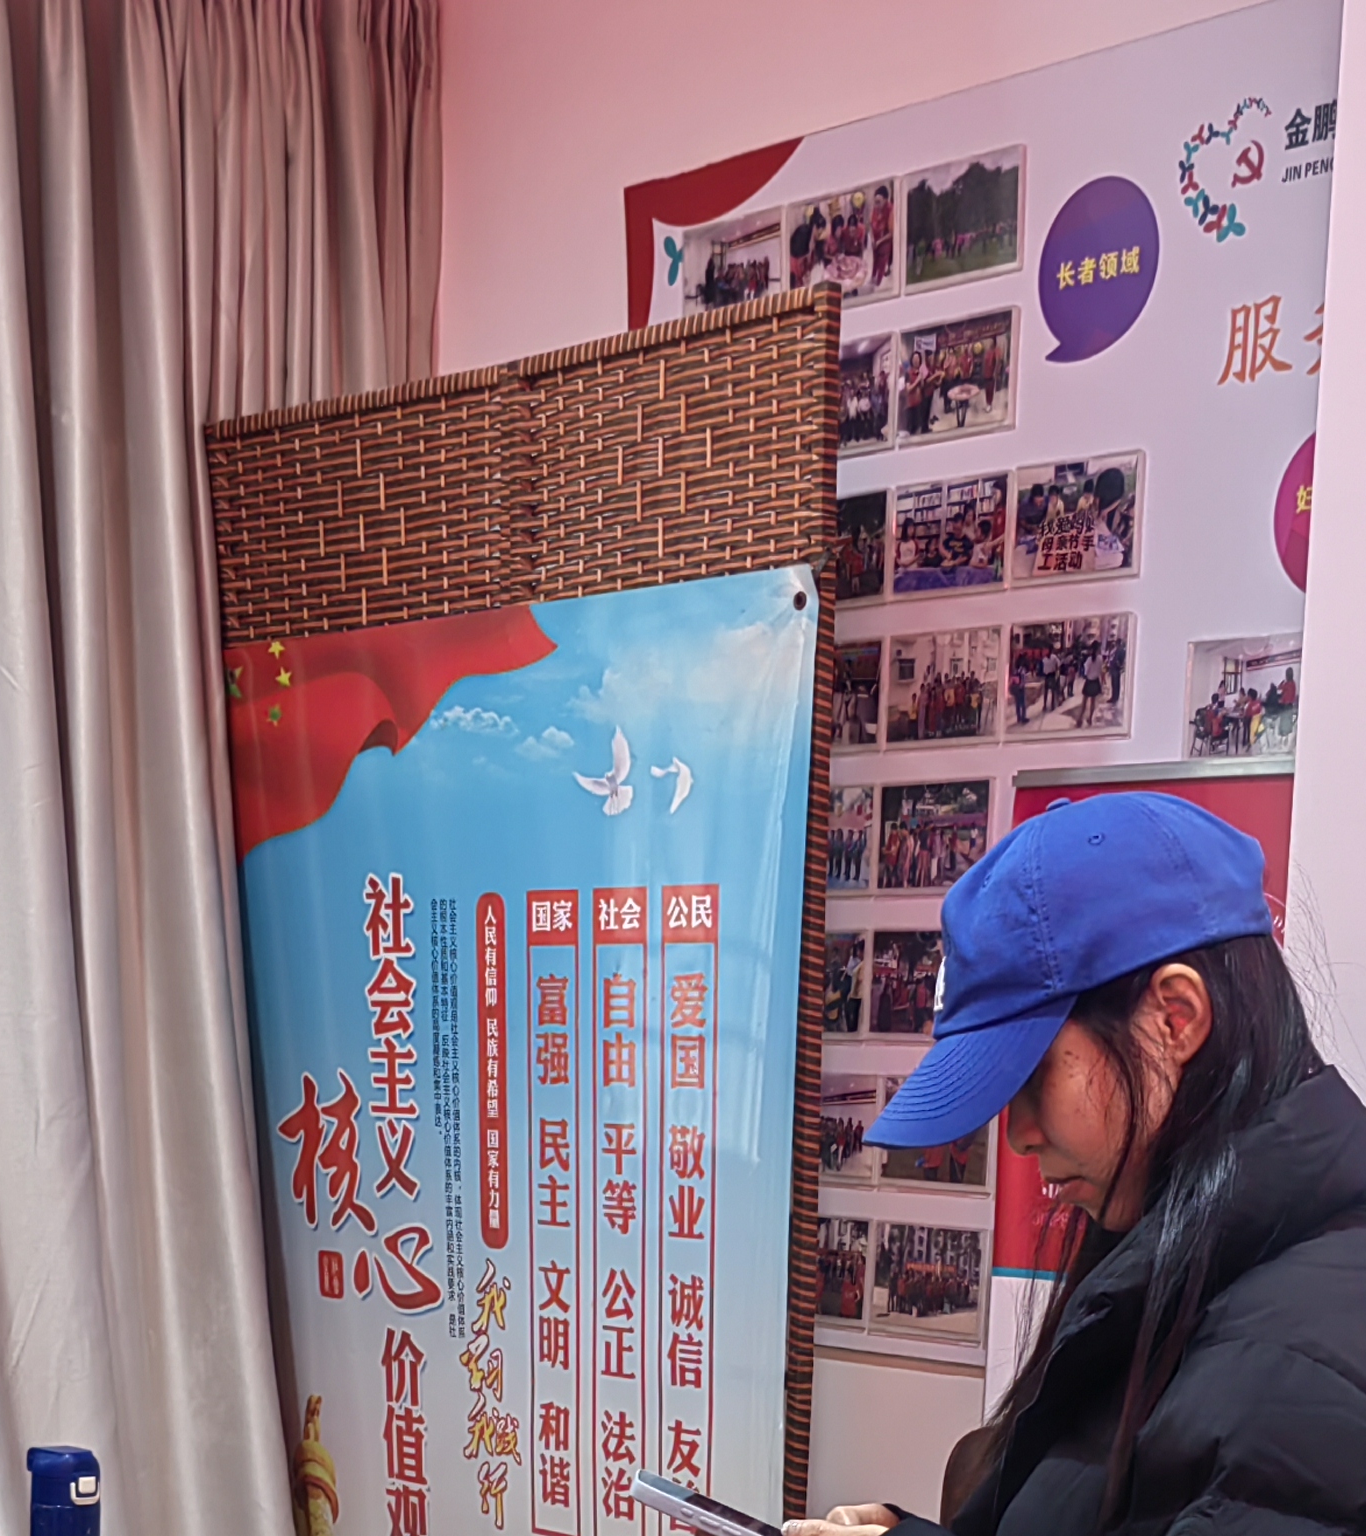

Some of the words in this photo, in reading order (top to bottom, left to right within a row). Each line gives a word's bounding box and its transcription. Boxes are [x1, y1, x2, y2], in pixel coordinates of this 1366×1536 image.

[1281, 166, 1302, 183] JIN
[1284, 98, 1337, 151] 金鹏
[1056, 246, 1140, 291] 长者领域
[484, 905, 497, 1007] 人民有信仰
[532, 900, 573, 932] 国家
[598, 898, 642, 931] 社会
[666, 894, 712, 928] 公民
[364, 873, 419, 1199] 社会主义
[487, 1018, 499, 1117] 民族有希望
[536, 974, 570, 1085] 富强
[602, 973, 637, 1088] 自由
[670, 973, 708, 1090] 爱国
[278, 1070, 442, 1311] 核心
[487, 1129, 500, 1229] 国家有力量
[538, 1117, 571, 1227] 民主
[601, 1122, 637, 1235] 平等
[668, 1124, 706, 1240] 敬业
[538, 1260, 571, 1371] 文明
[600, 1268, 636, 1380] 公正
[667, 1273, 704, 1389] 诚信
[538, 1401, 571, 1508] 和谐
[601, 1410, 636, 1521] 法治
